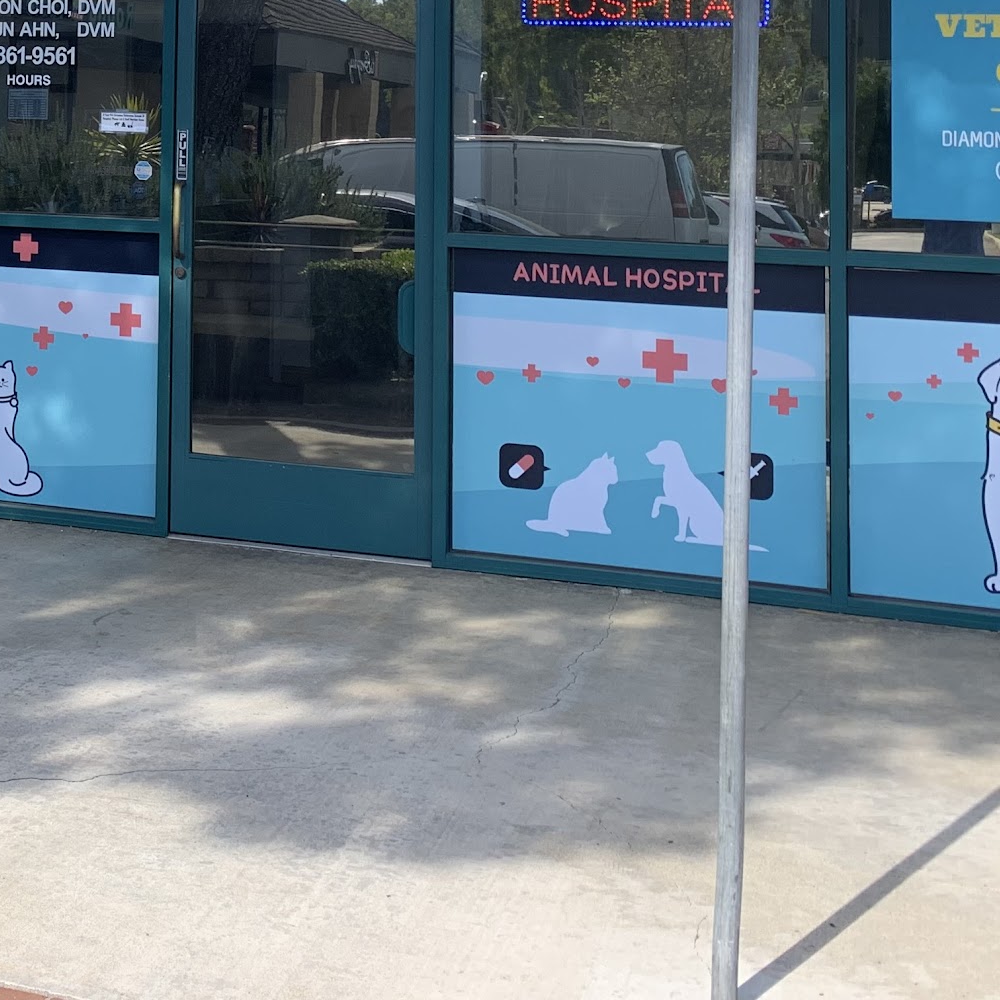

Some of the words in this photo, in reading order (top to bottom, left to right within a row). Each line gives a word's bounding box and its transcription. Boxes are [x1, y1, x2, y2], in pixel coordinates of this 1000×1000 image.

[27, 0, 72, 18] CHOI,
[77, 0, 116, 15] DVM
[19, 21, 60, 40] AHN,
[76, 21, 115, 38] DVM
[6, 74, 51, 86] HOURS
[178, 132, 187, 167] PULL
[513, 262, 618, 287] ANIMAL
